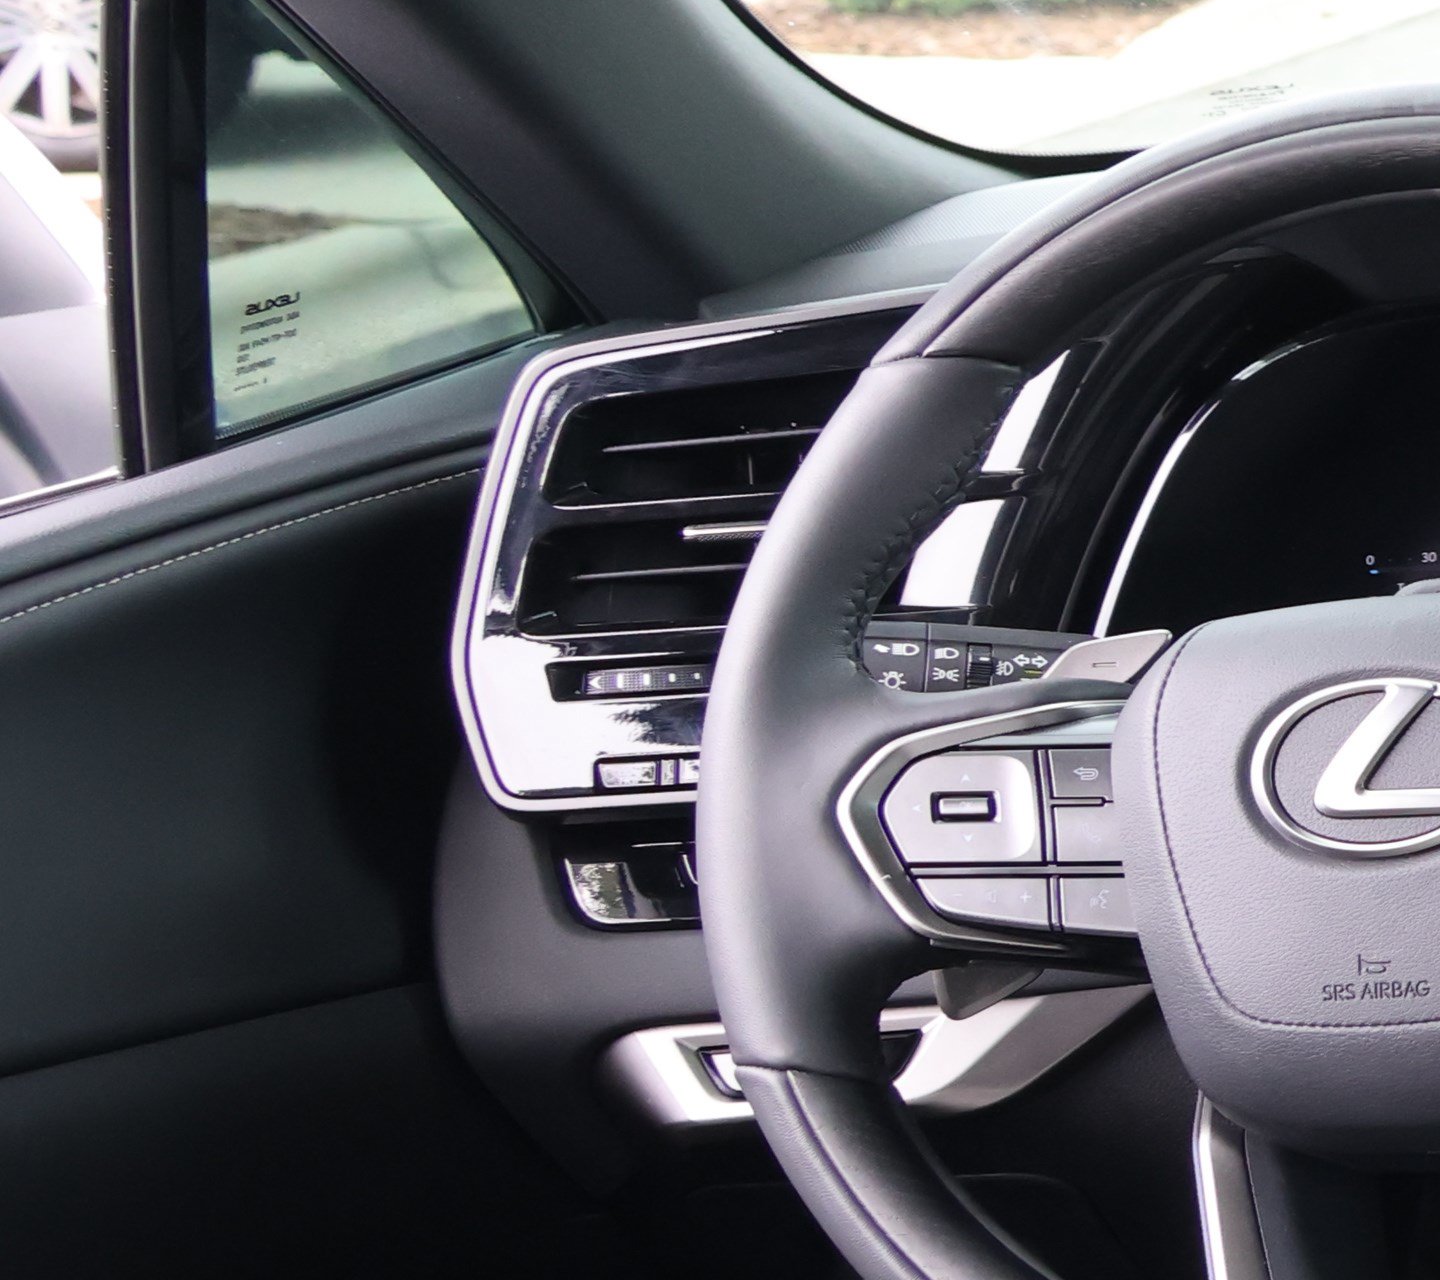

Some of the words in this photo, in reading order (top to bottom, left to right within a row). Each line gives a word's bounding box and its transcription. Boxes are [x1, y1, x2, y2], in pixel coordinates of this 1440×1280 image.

[1365, 555, 1375, 567] 0
[1421, 551, 1437, 563] 30
[1322, 982, 1356, 1002] SRS
[1361, 979, 1431, 1001] AIRBAG
